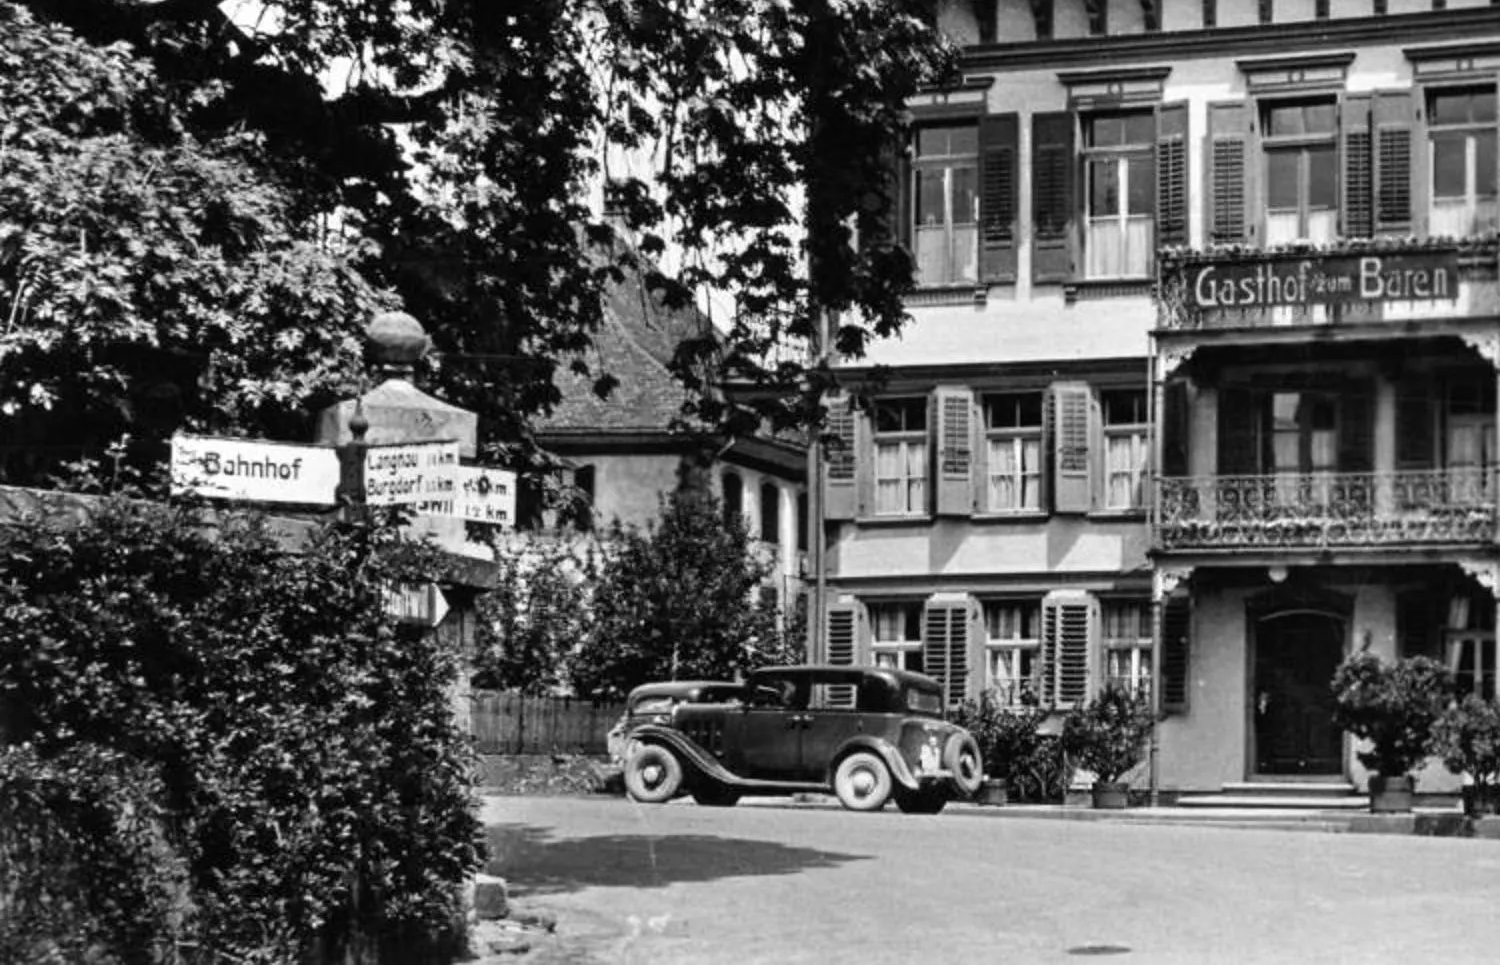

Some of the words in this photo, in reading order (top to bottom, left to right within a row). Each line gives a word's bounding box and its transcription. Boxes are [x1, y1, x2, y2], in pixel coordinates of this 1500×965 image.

[1195, 261, 1312, 306] Gasthof
[1315, 272, 1351, 293] zum
[205, 451, 303, 480] Bahnhof
[367, 452, 418, 475] Langnau
[367, 474, 423, 501] Burgdorf
